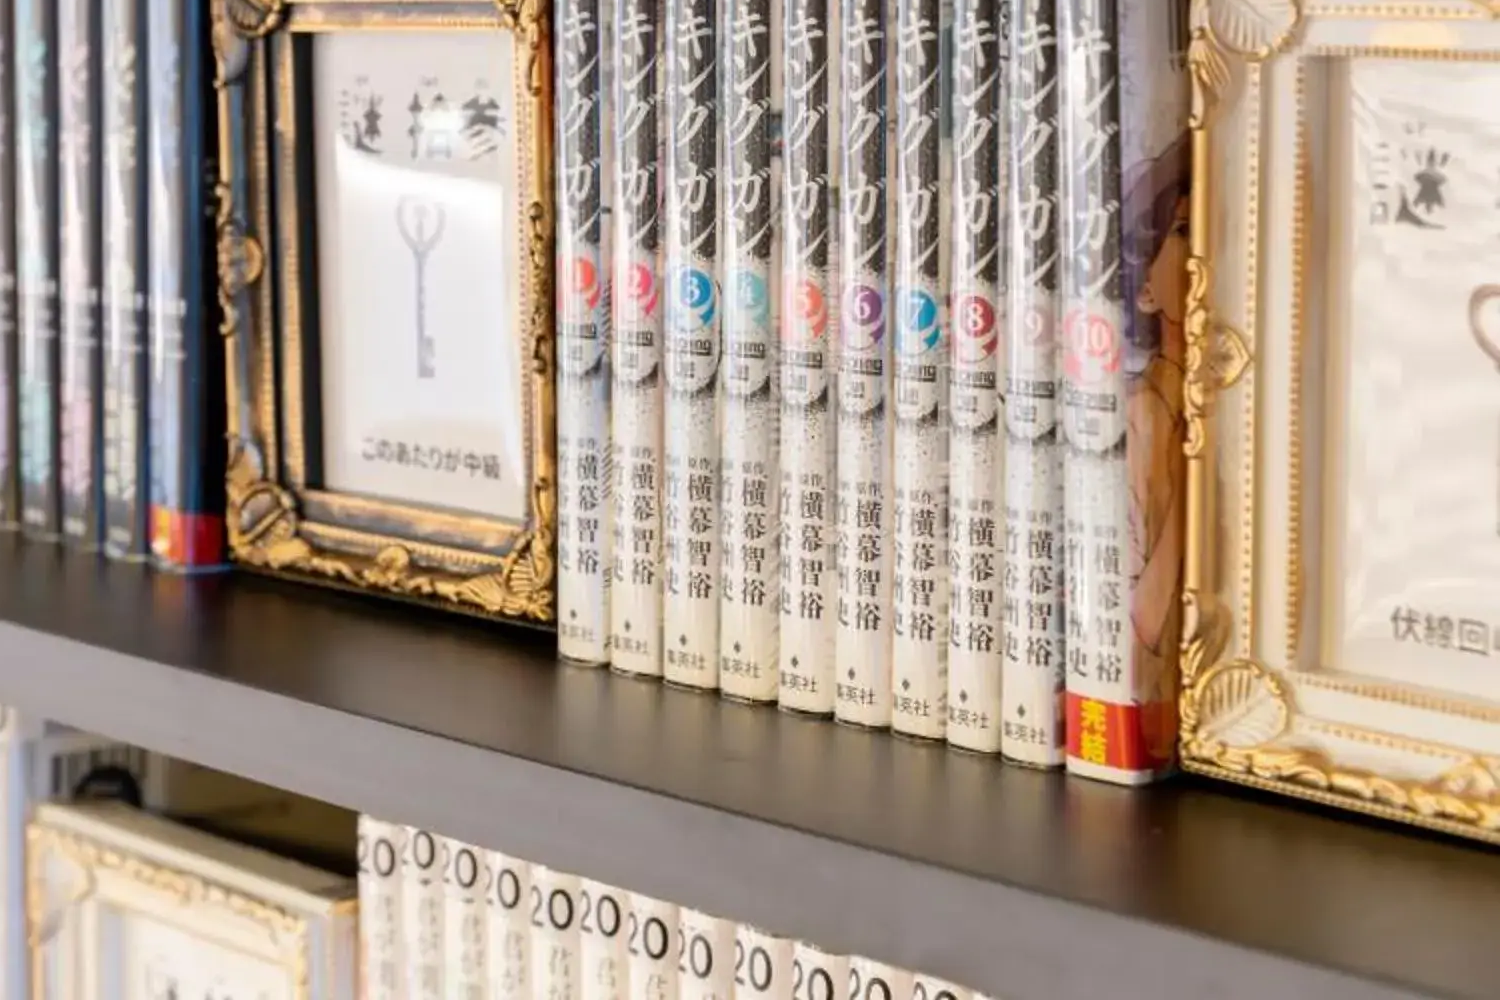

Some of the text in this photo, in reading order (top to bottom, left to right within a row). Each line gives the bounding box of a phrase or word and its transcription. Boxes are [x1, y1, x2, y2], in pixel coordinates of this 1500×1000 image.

[1390, 603, 1500, 657] 伏線回
[531, 885, 574, 931] 20
[581, 890, 621, 937] 20
[628, 911, 669, 960] 20
[734, 939, 772, 991] 20
